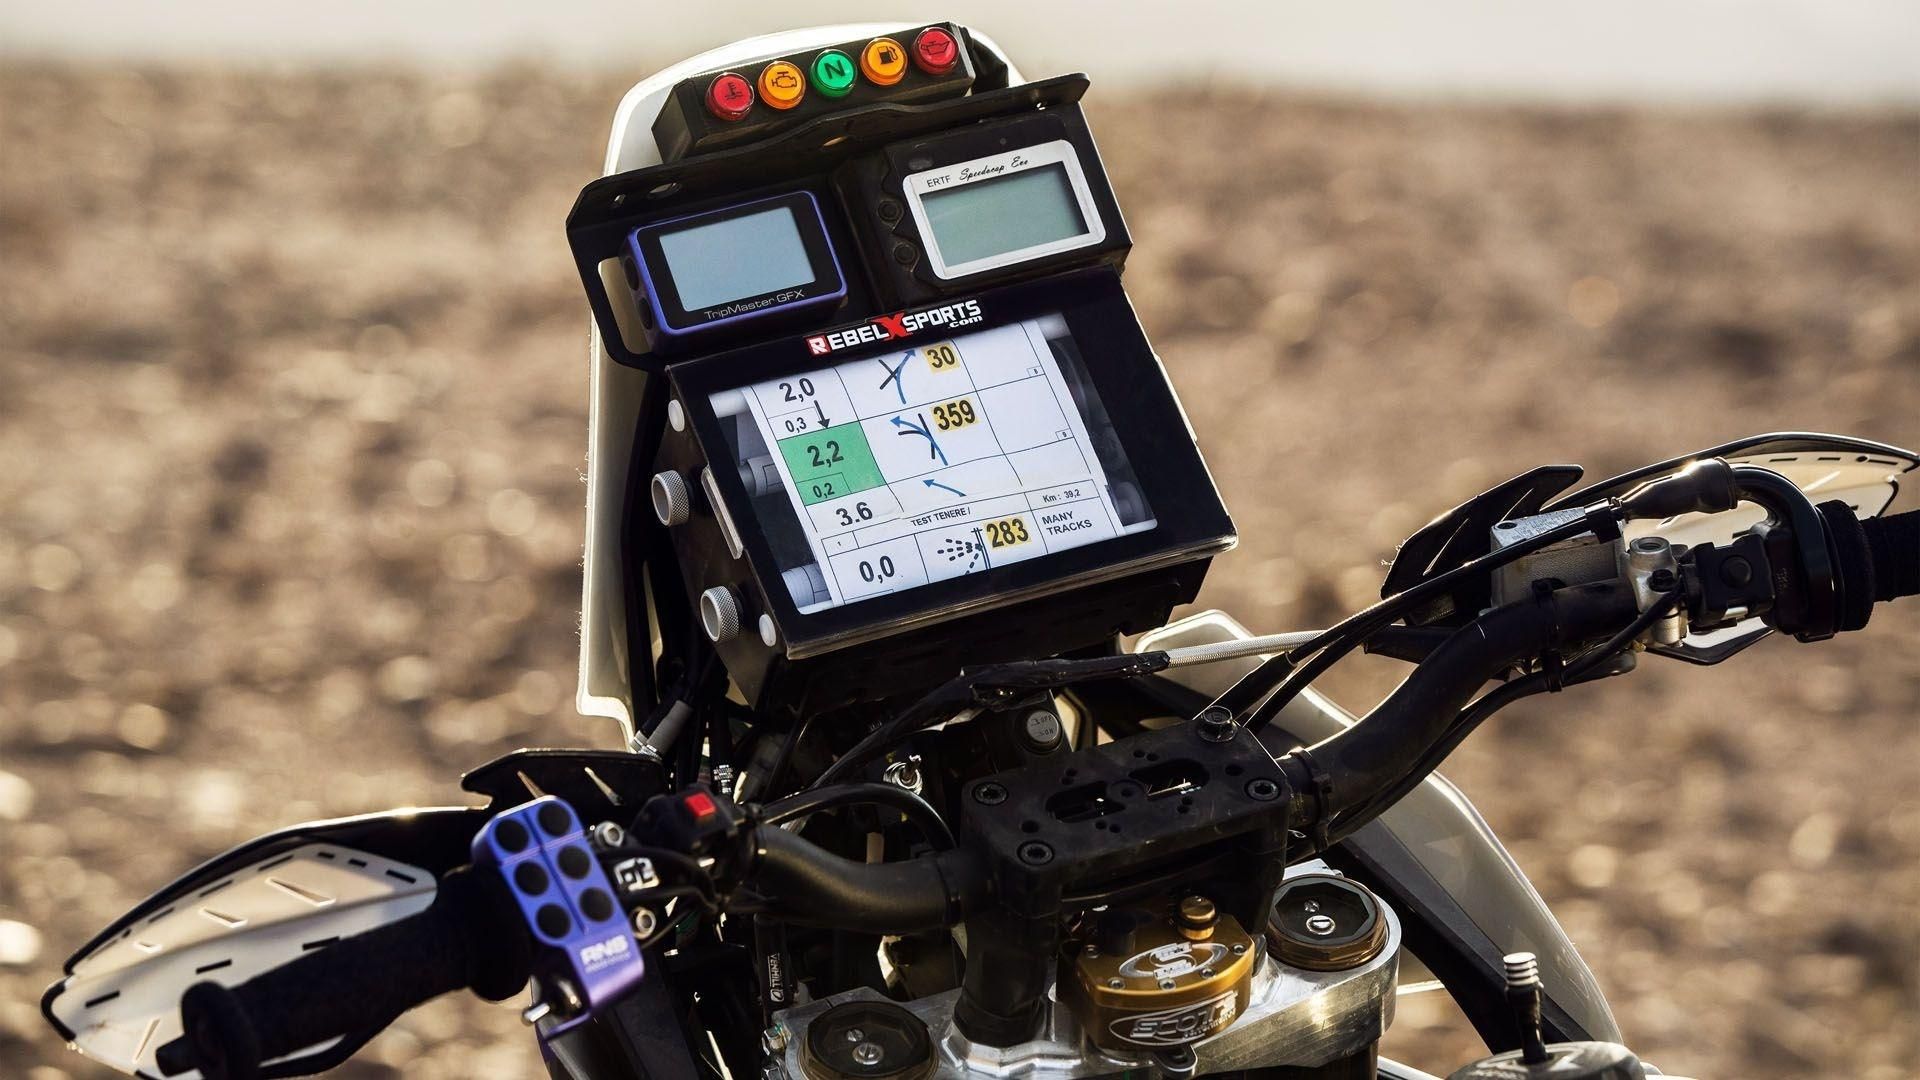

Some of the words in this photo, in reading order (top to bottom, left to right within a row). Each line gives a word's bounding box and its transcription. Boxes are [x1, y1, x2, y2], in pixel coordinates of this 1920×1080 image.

[824, 60, 845, 79] N
[926, 174, 951, 188] ERTF
[704, 297, 775, 321] TripMaster
[776, 289, 805, 304] GFX
[808, 299, 982, 355] REBELXSPORTS
[927, 346, 955, 369] 30
[779, 377, 815, 402] 2,0
[785, 416, 807, 434] 0,3
[933, 399, 976, 431] 359
[807, 440, 844, 468] 2,2
[813, 482, 835, 499] 0,2
[1063, 488, 1081, 499] 39,2
[836, 501, 873, 526] 3.6
[910, 515, 932, 527] TEST
[933, 507, 967, 521] TENERE
[1041, 510, 1073, 525] MANY
[986, 518, 1030, 549] 283
[1046, 519, 1092, 535] TRACKS
[859, 555, 895, 584] 0,0
[770, 953, 782, 988] VENHILL
